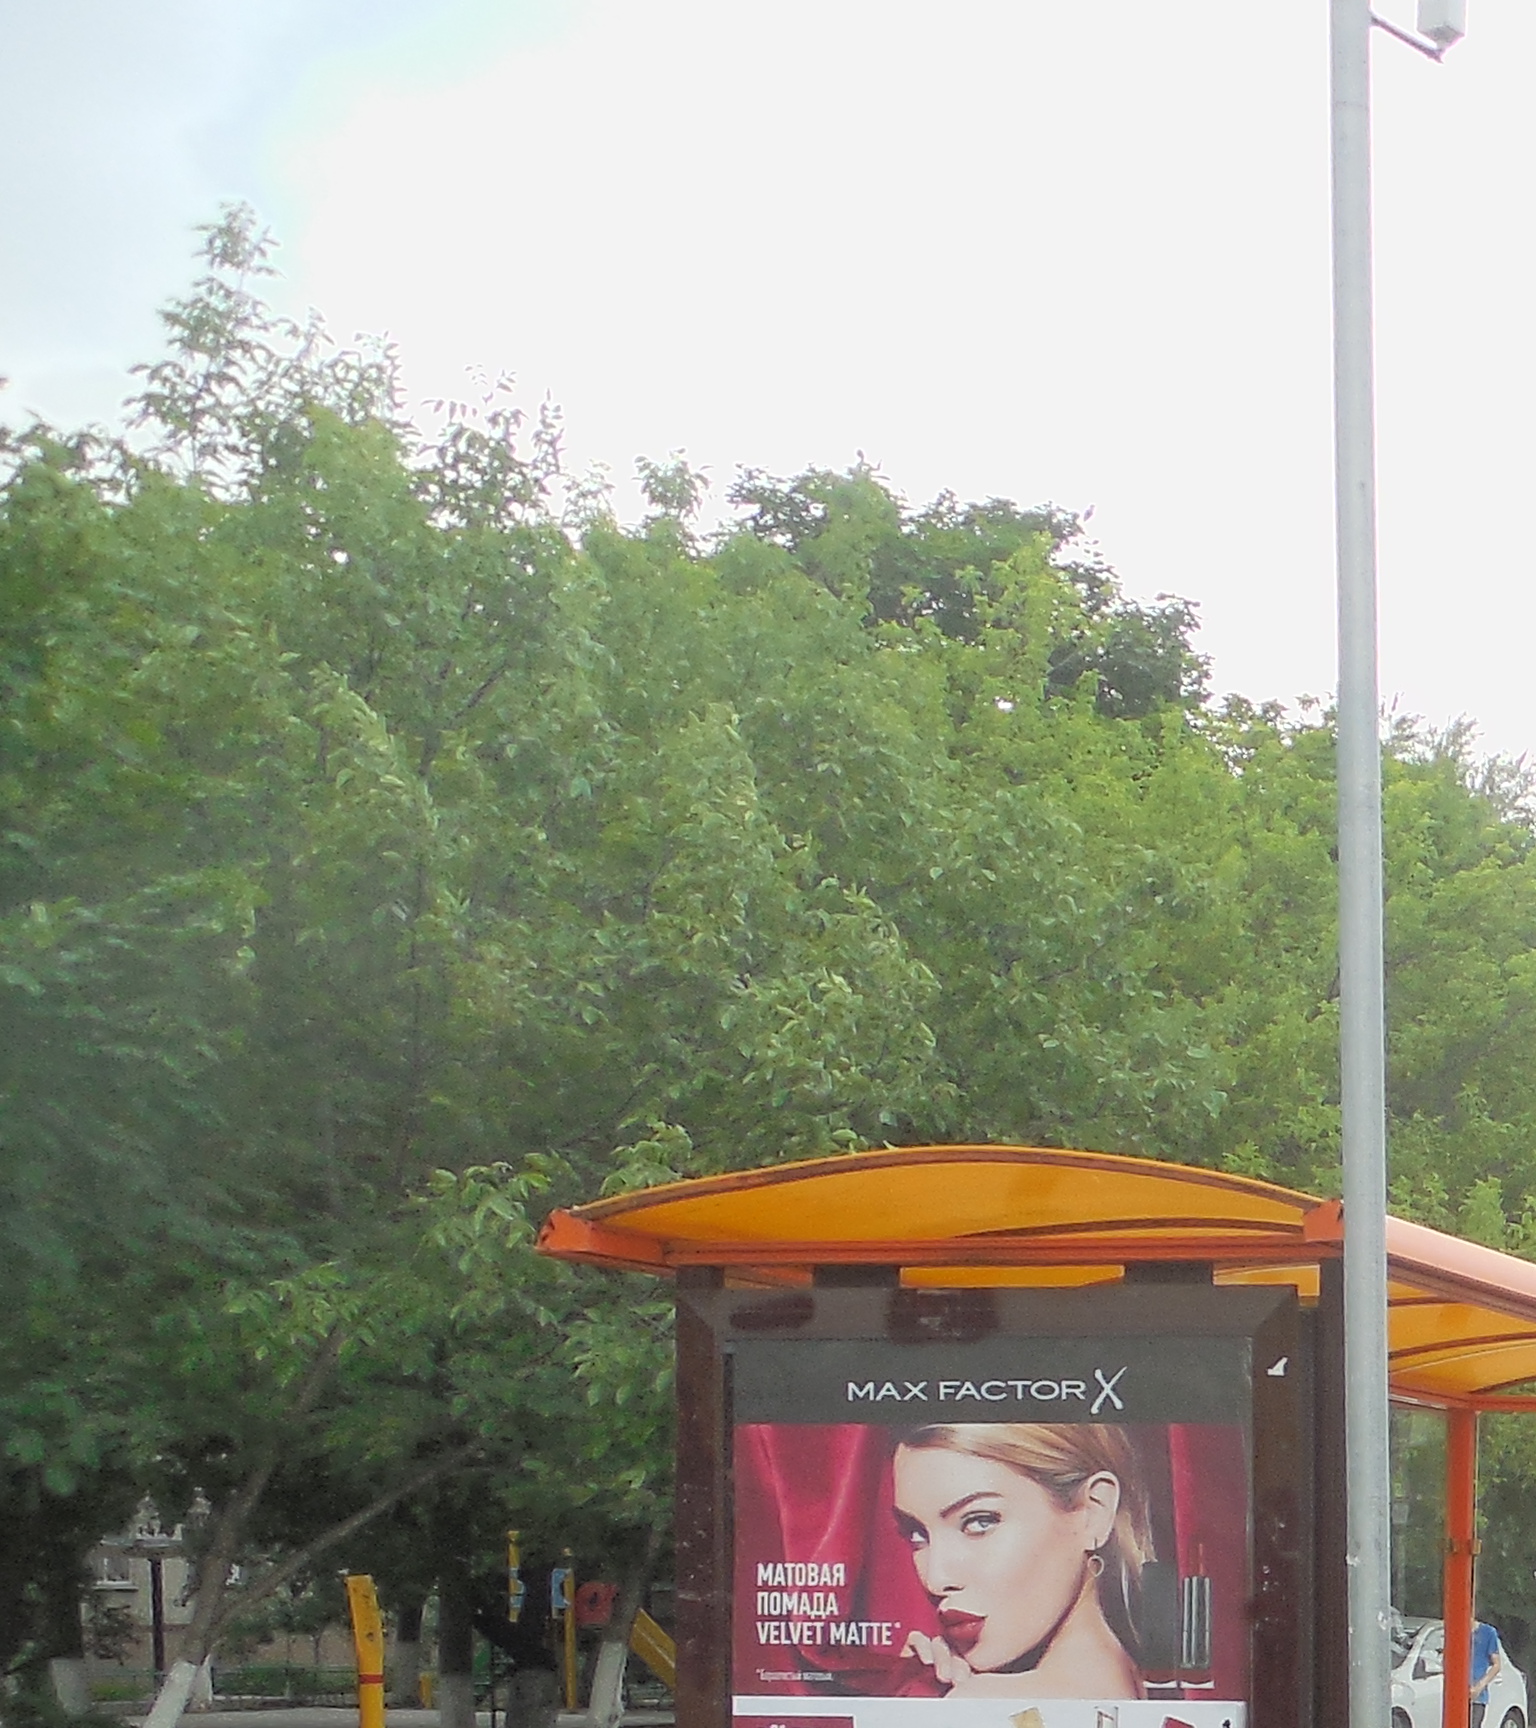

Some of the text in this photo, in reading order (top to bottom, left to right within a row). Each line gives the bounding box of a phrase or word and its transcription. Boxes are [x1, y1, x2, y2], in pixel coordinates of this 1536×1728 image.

[847, 1381, 928, 1401] MAX
[939, 1380, 1087, 1401] FACTOR
[756, 1563, 845, 1587] МАТОВАЯ
[756, 1592, 839, 1619] ПОМАДА
[756, 1621, 824, 1645] VELVET
